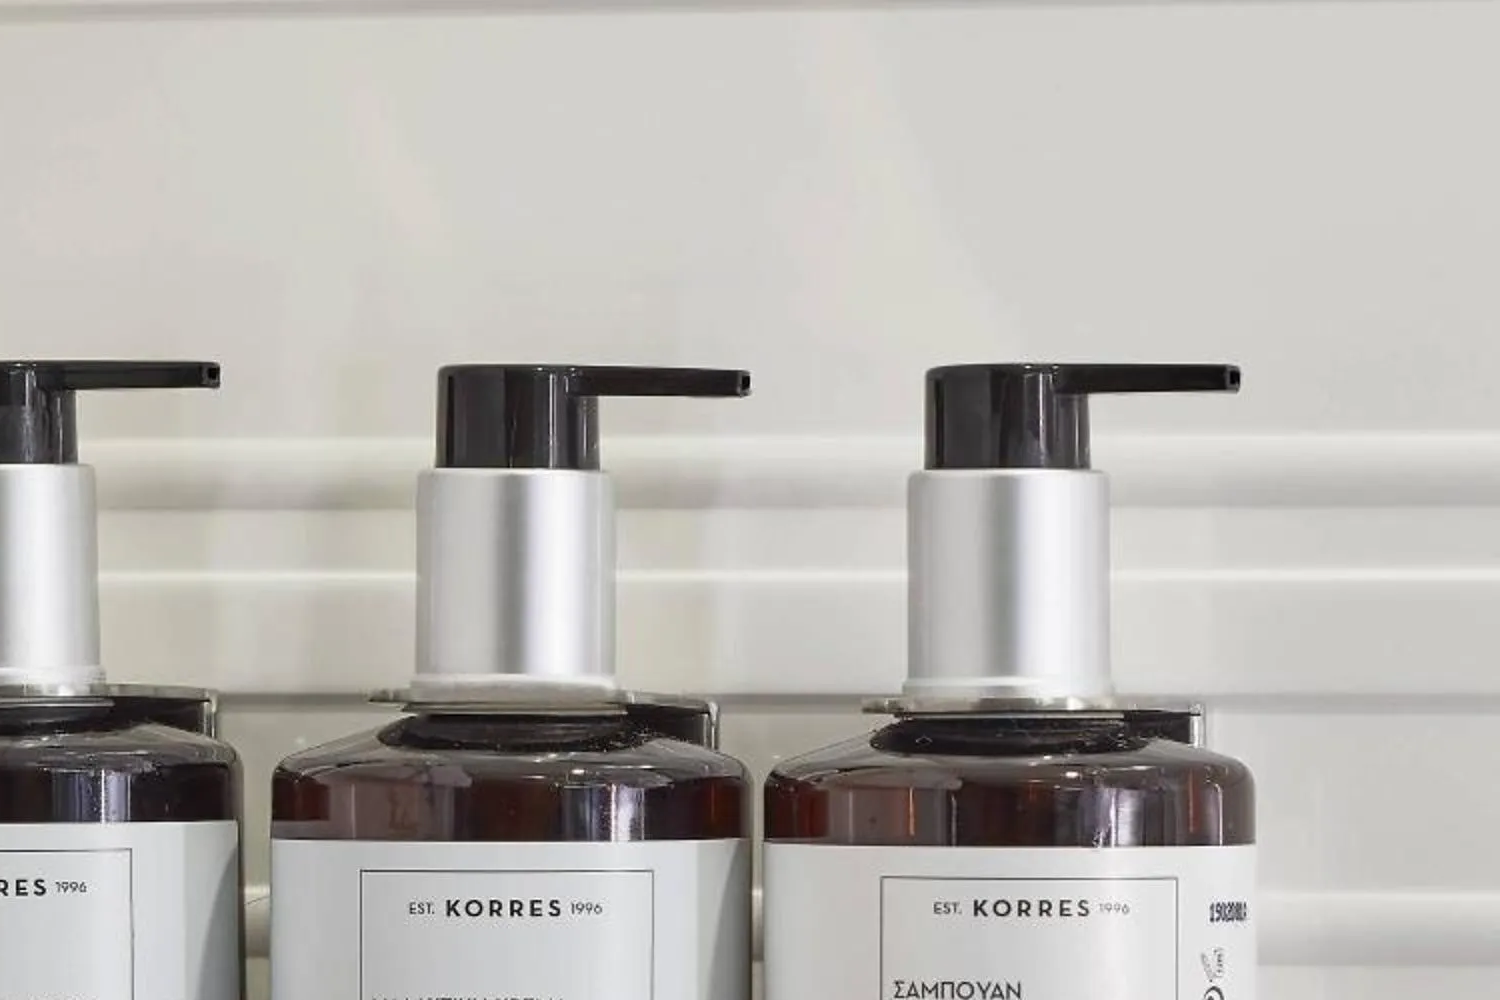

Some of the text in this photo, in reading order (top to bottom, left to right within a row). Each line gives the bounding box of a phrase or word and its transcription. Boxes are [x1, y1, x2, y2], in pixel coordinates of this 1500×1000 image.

[56, 881, 87, 894] 1996
[408, 899, 603, 917] EST. KORRES 1996
[933, 899, 1130, 917] EST. KORRES 1996
[894, 980, 1022, 1000] ΣΑΜΠΟΥΑΝ
